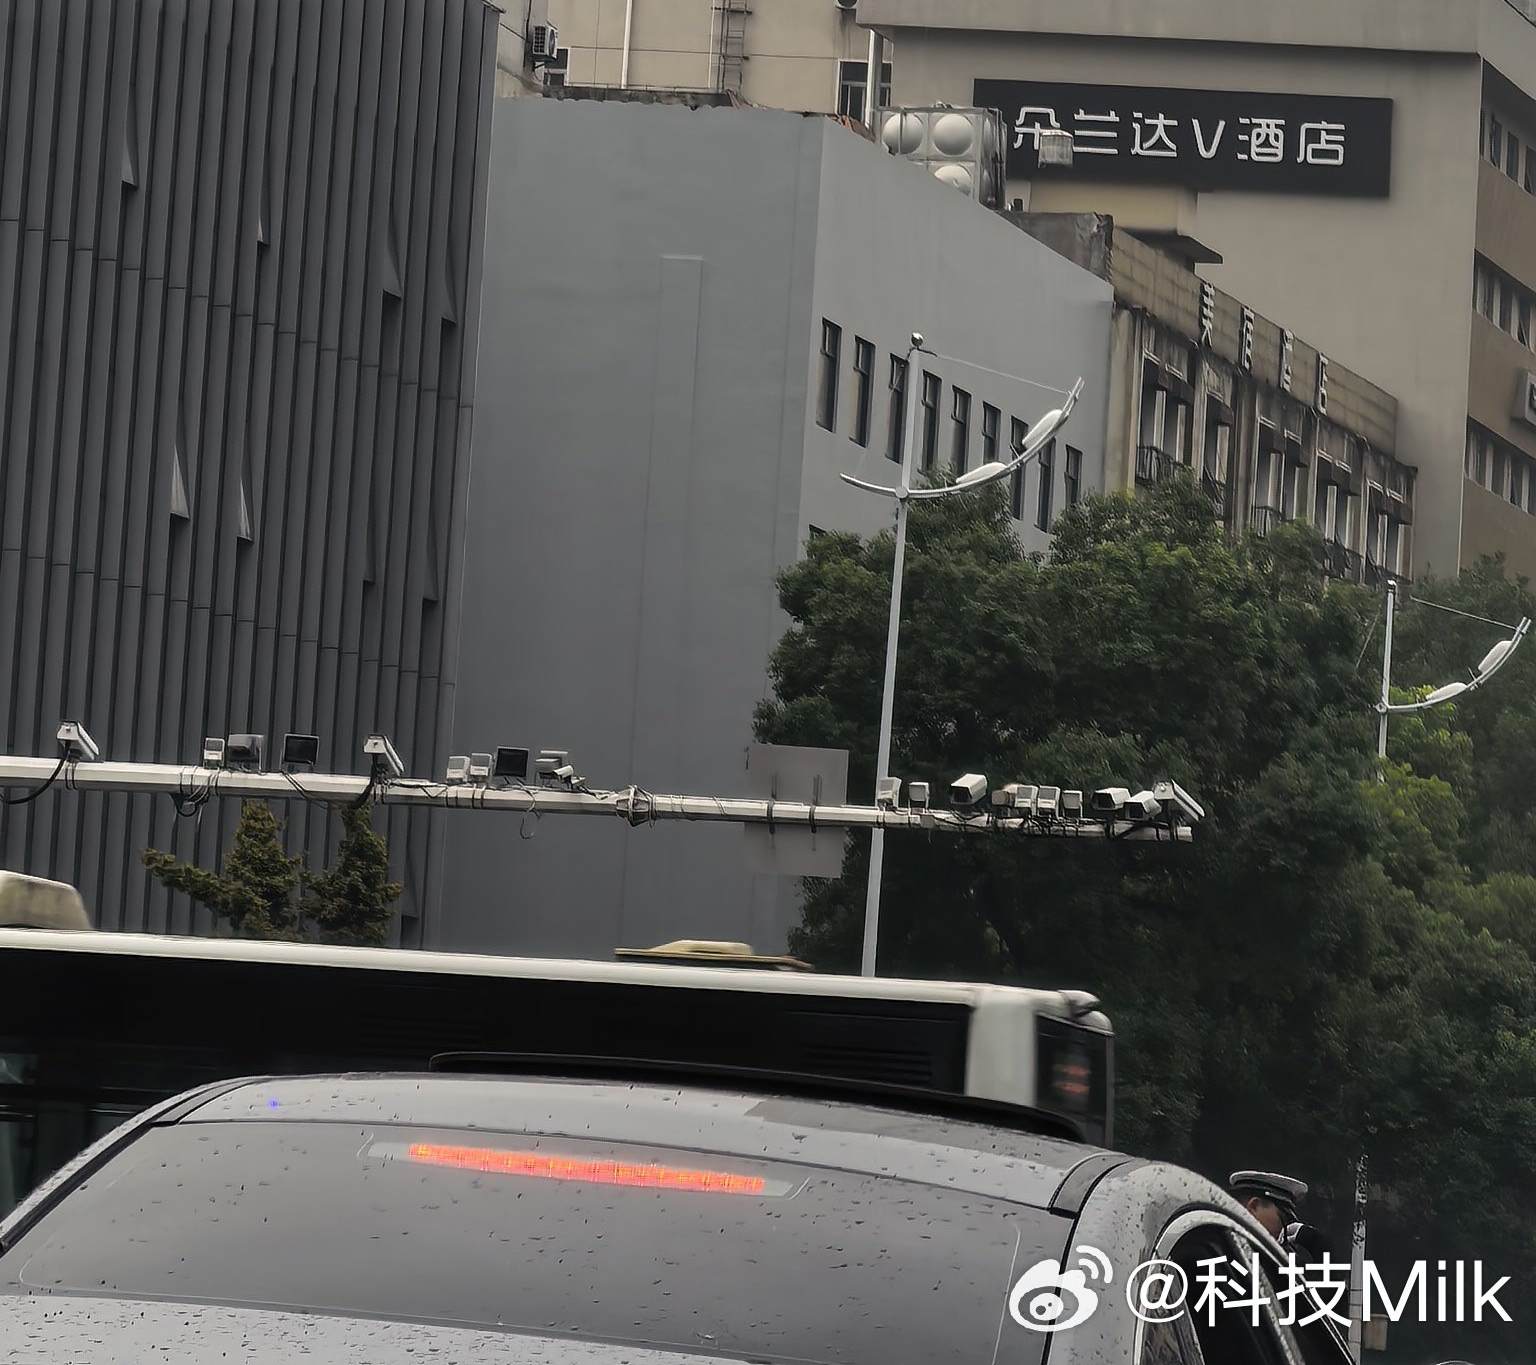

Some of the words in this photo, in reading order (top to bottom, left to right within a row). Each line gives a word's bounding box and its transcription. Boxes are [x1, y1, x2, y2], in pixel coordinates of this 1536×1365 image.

[1014, 106, 1346, 166] 朵兰达V酒店
